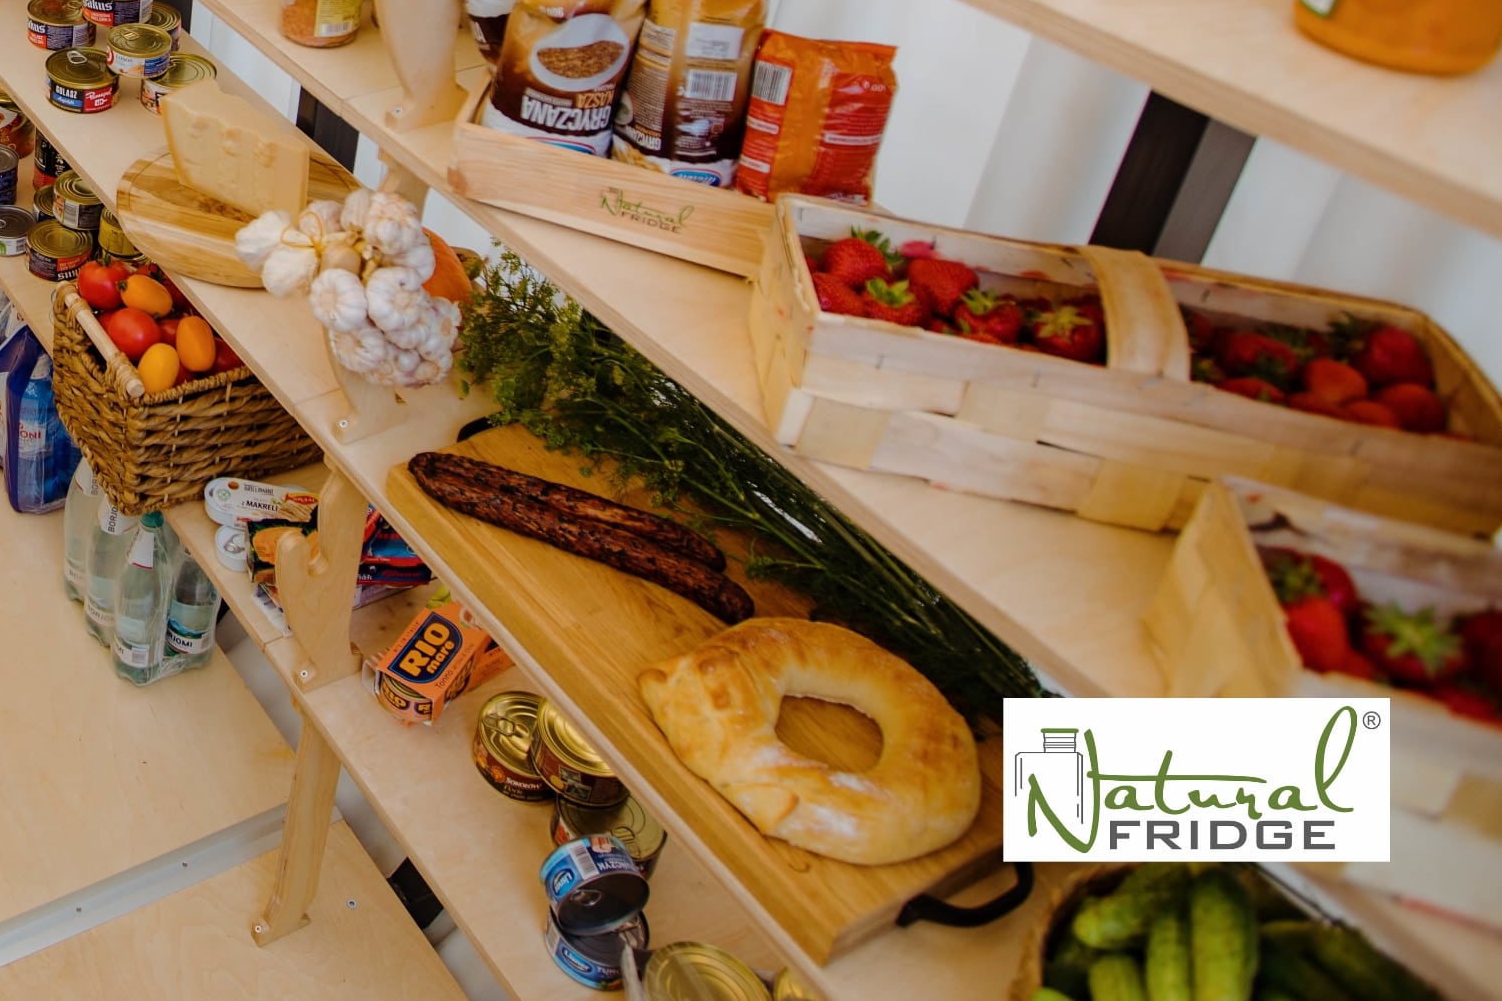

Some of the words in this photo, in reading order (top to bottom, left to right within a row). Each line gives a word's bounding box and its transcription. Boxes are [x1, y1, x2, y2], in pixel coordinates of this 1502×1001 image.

[576, 92, 615, 107] KASZA
[520, 96, 612, 131] GRYCZANA
[600, 186, 695, 228] Natural
[621, 211, 682, 235] FRIDGE
[246, 500, 278, 512] MAKRELI
[107, 506, 118, 533] BORJO
[167, 628, 194, 648] RJOMI
[399, 622, 451, 677] RIO
[426, 640, 456, 675] mare
[434, 669, 455, 690] Tonno
